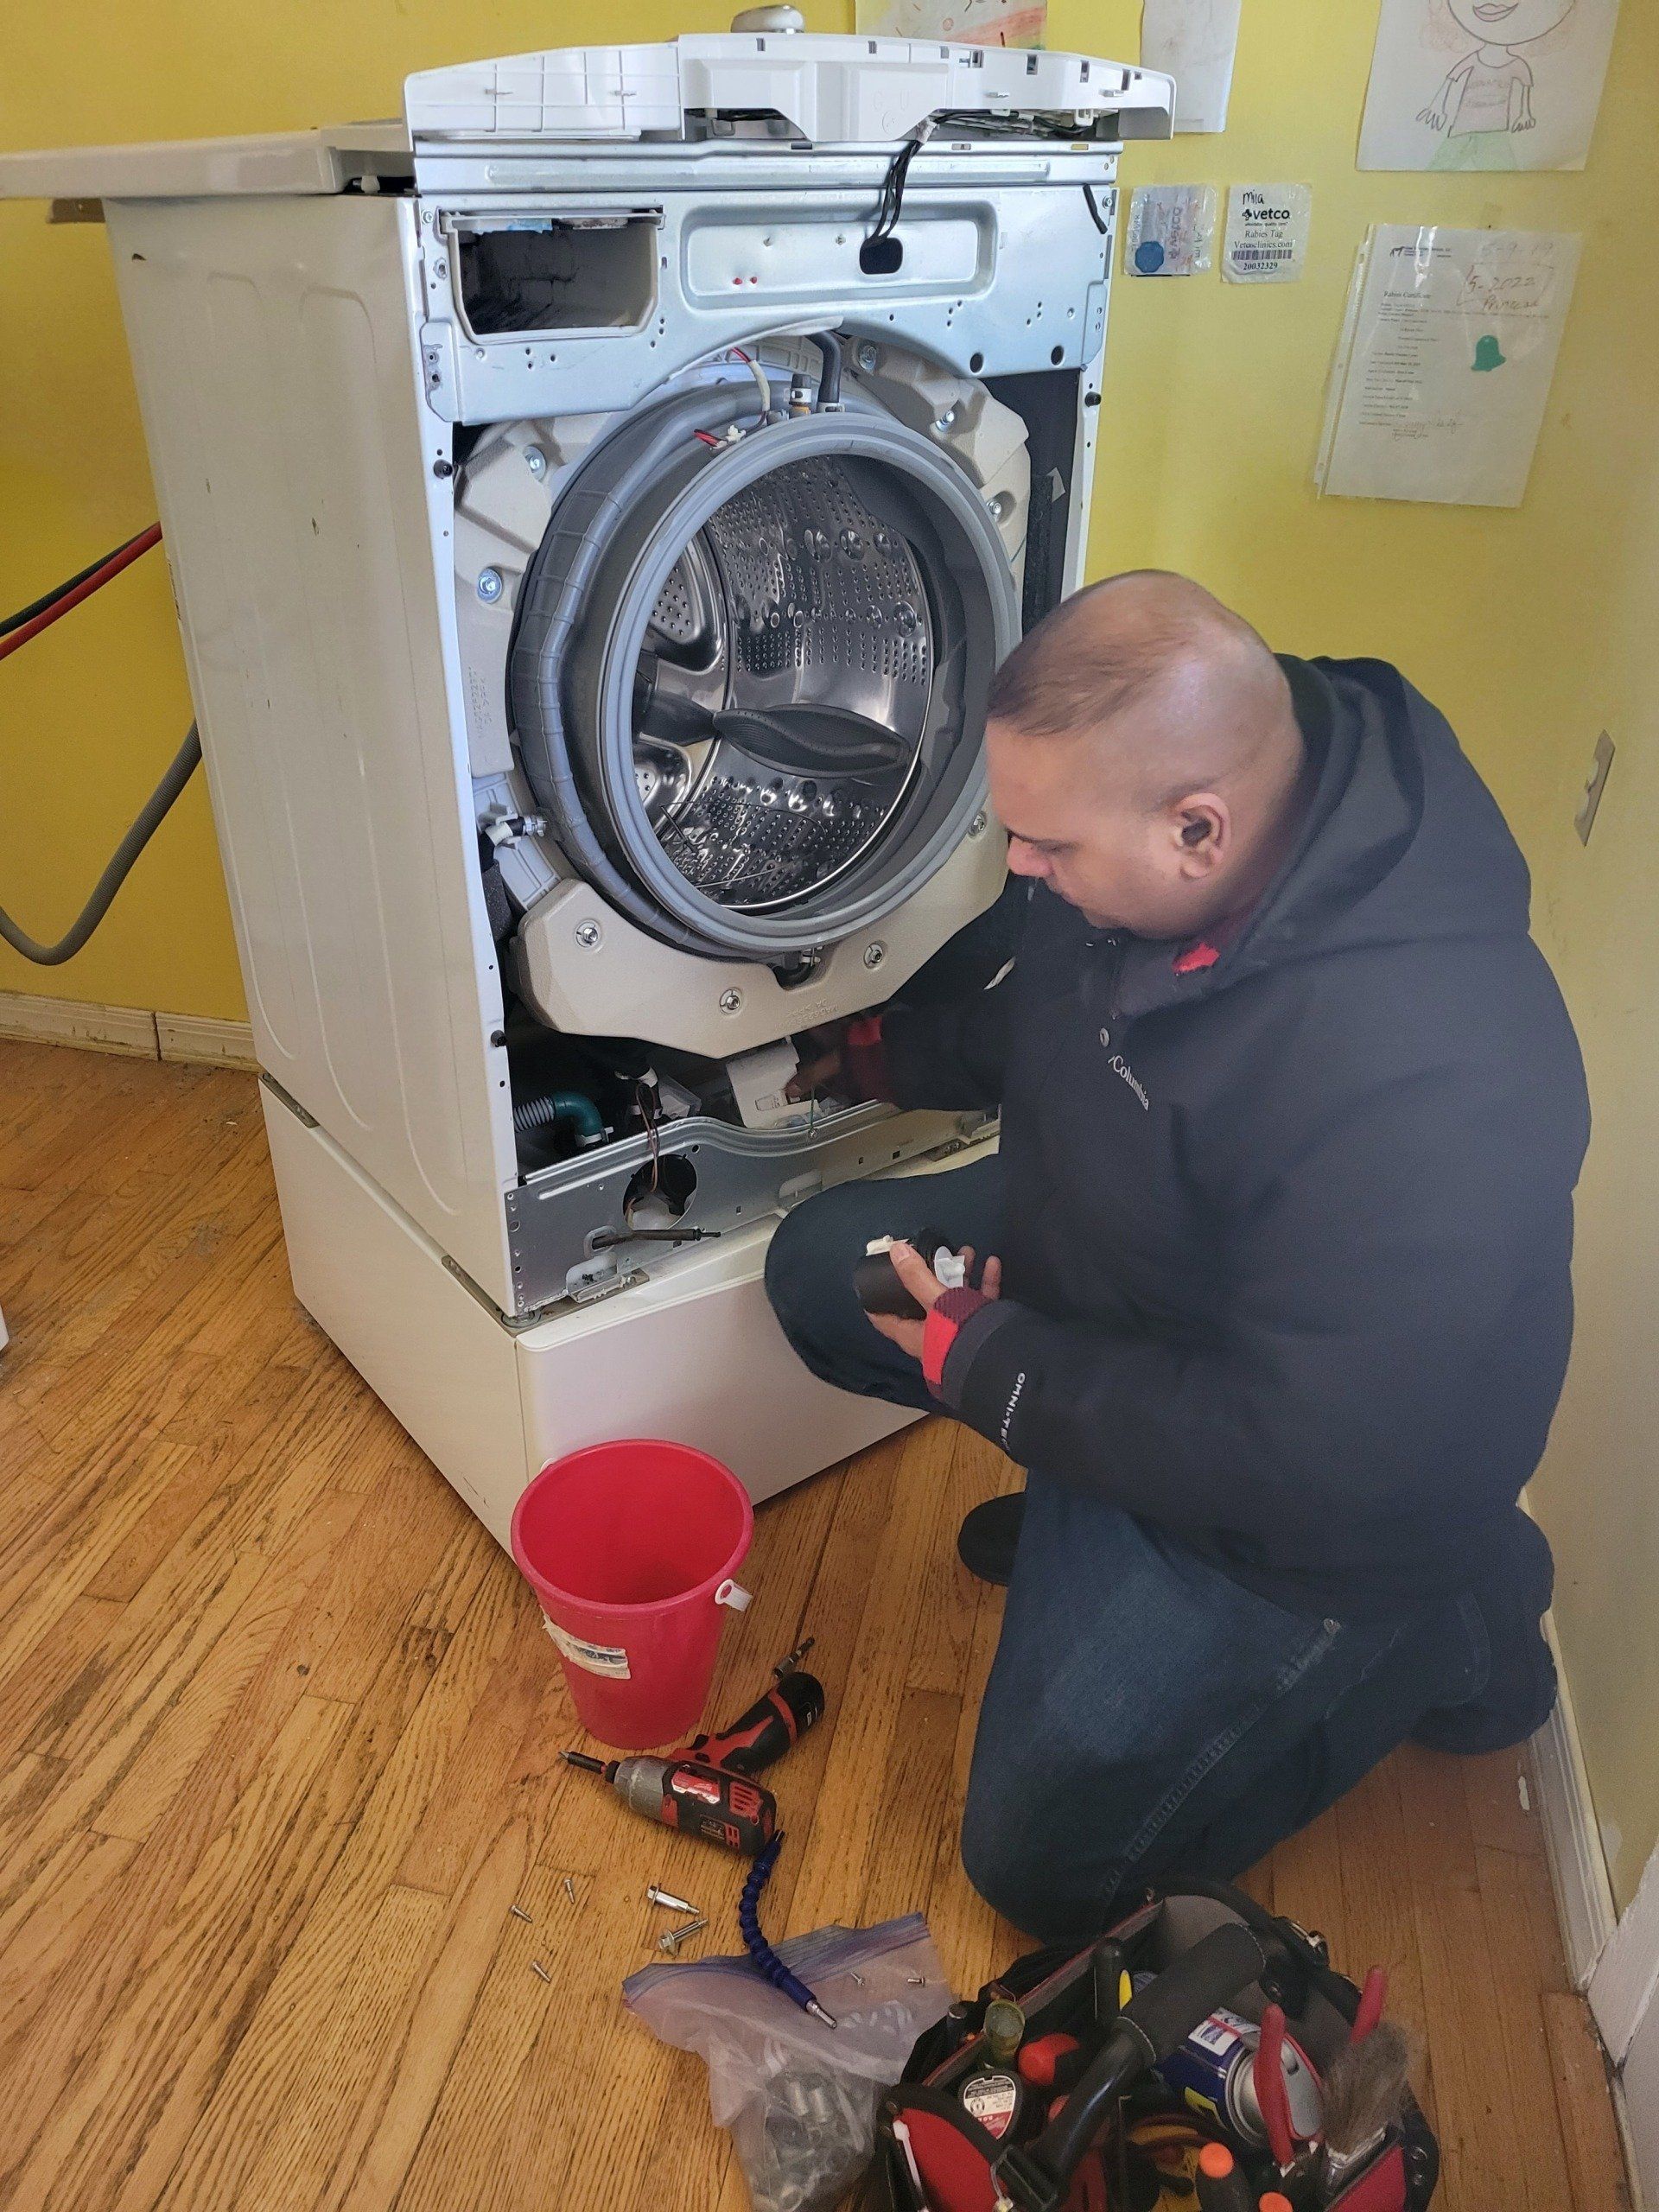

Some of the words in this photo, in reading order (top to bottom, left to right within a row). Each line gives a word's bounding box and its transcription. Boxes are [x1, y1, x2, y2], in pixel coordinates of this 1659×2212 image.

[1253, 208, 1290, 220] vetco
[1245, 230, 1268, 238] Rabies
[1271, 229, 1283, 238] Tag
[1243, 262, 1278, 270] 20032329
[1113, 1055, 1149, 1111] Columbia
[1001, 1372, 1026, 1449] OMNI-TE
